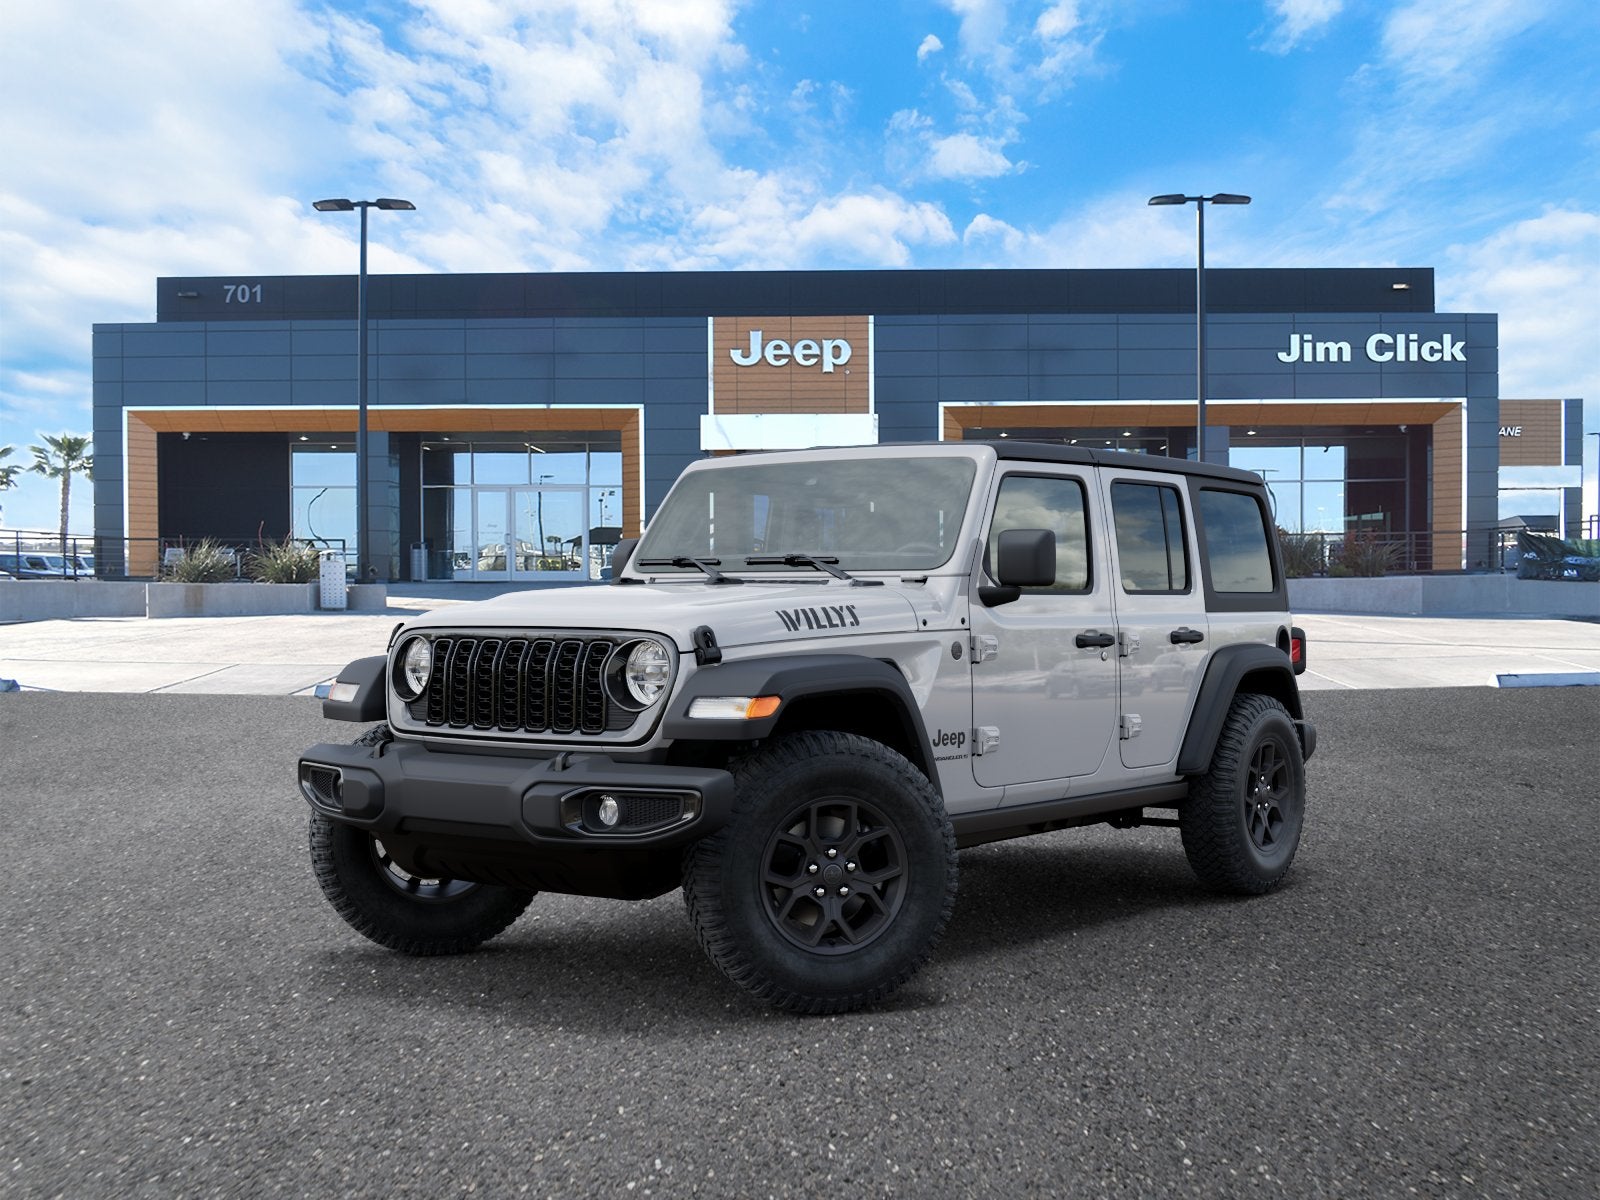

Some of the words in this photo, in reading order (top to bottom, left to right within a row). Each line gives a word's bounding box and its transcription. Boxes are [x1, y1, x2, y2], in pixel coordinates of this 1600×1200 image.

[223, 284, 261, 303] 701
[729, 330, 852, 373] Jeep
[1277, 334, 1351, 363] Jim
[1366, 333, 1467, 362] Click
[775, 604, 860, 632] WILLYS
[932, 729, 966, 748] Jeep
